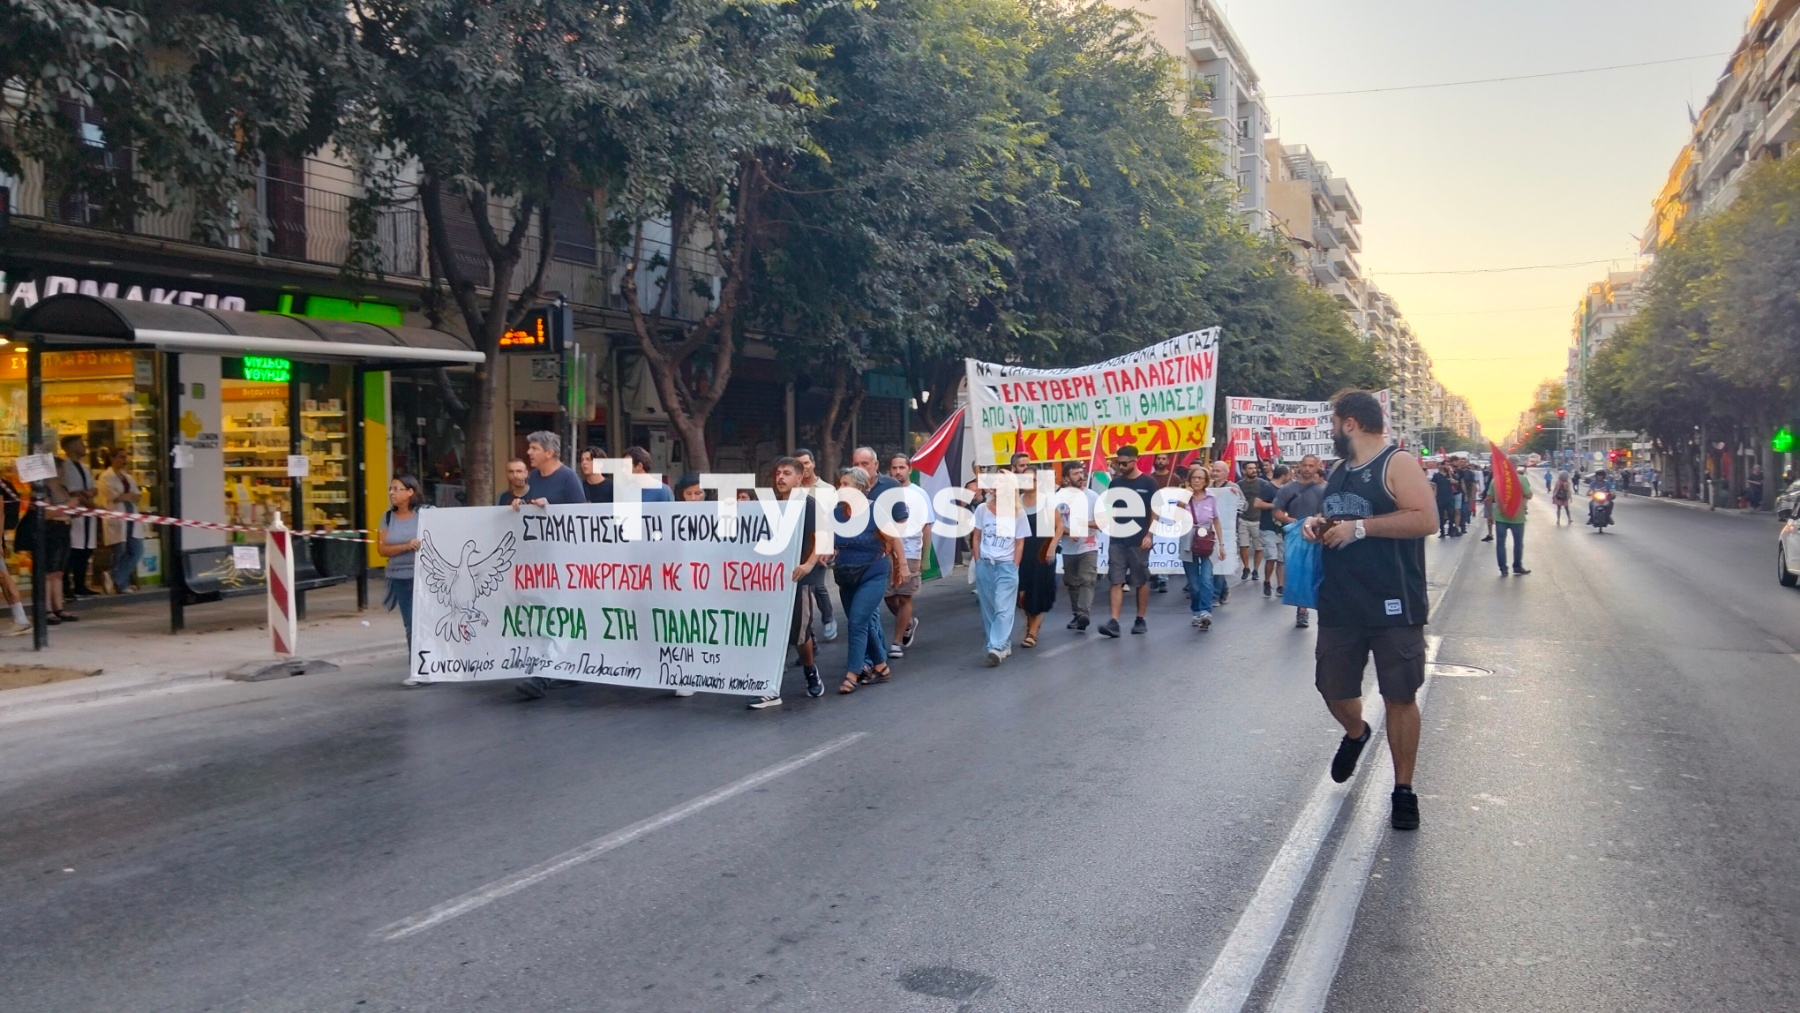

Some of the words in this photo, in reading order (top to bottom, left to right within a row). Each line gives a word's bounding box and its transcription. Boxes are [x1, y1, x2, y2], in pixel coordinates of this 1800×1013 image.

[0, 271, 246, 311] ΑΡΜΑΚΕΙΟ
[975, 362, 992, 377] ΝΑ
[1162, 339, 1181, 358] ΣΤΗ
[1187, 330, 1220, 352] ΓΑΖΑ
[1001, 373, 1097, 403] ΕΛΕΥΘΕΡΗ
[1103, 351, 1214, 395] ΠΑΛΑΙΣΤΙΝΗ
[982, 406, 1005, 429] ΑΠΟ
[1013, 404, 1035, 426] ΤΟΝ
[1041, 401, 1089, 424] ΠΟΤΑΜΟ
[1095, 399, 1112, 419] ΩΣ
[1115, 396, 1132, 417] ΤΗ
[1140, 385, 1204, 416] ΘΑΛΑΣΣΑ
[641, 514, 663, 542] ΤΗ
[514, 562, 561, 591] ΚΑΜΙΑ
[566, 561, 653, 591] ΣΥΝΕΡΓΑΣΙΑ
[662, 562, 683, 591] ΜΕ
[690, 561, 710, 591] ΤΟ
[723, 561, 785, 592] ΙΣΡΑΗΛ
[501, 604, 588, 641] ΛΕΥΤΕΡΙΑ
[601, 607, 638, 642] ΣΤΗ
[652, 607, 770, 648] ΠΑΛΑΙΣΤΙΝΗ
[417, 651, 495, 678] Συντονισμός
[553, 661, 577, 673] στη
[659, 645, 694, 664] ΜΕΛΗ
[701, 651, 721, 664] της
